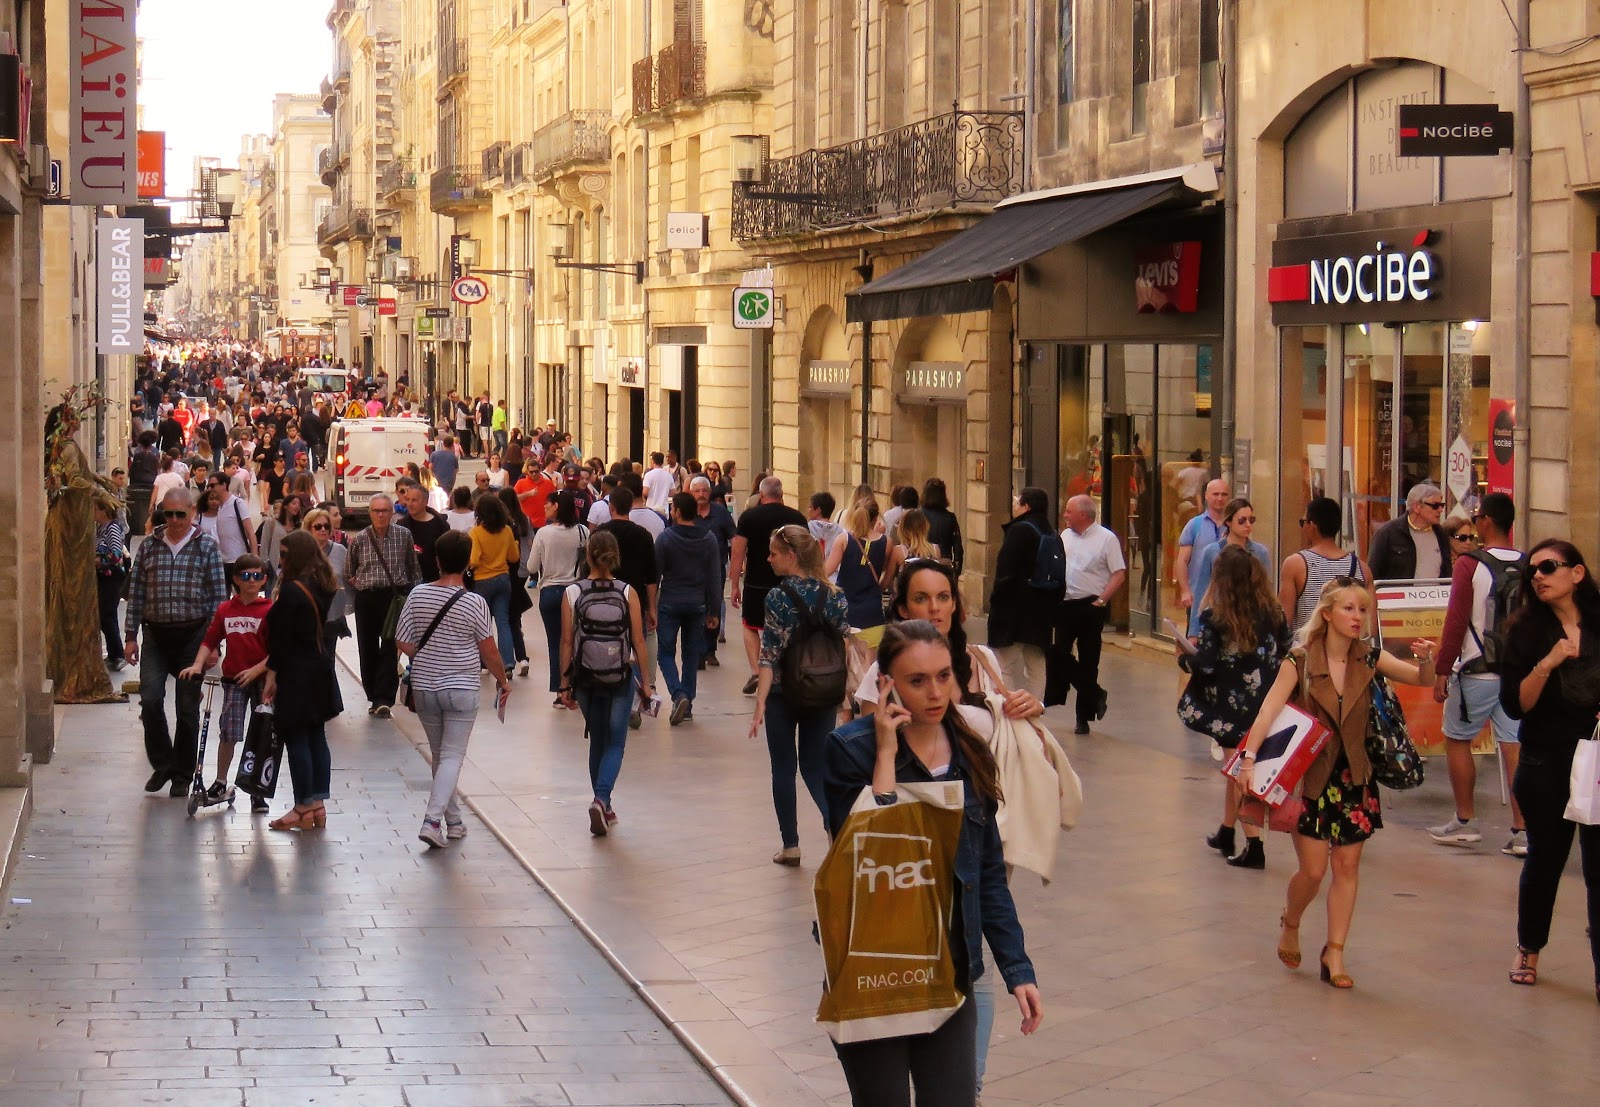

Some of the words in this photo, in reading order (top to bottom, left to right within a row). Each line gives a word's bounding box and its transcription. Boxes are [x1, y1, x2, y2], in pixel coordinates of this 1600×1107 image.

[111, 227, 132, 346] PULL&BEAR
[457, 282, 482, 297] C&A
[809, 367, 850, 384] PARASHOP
[905, 369, 962, 389] PARASHOP
[1408, 588, 1451, 599] NOCiB
[1405, 617, 1443, 627] NOCiB
[855, 857, 937, 893] fnac
